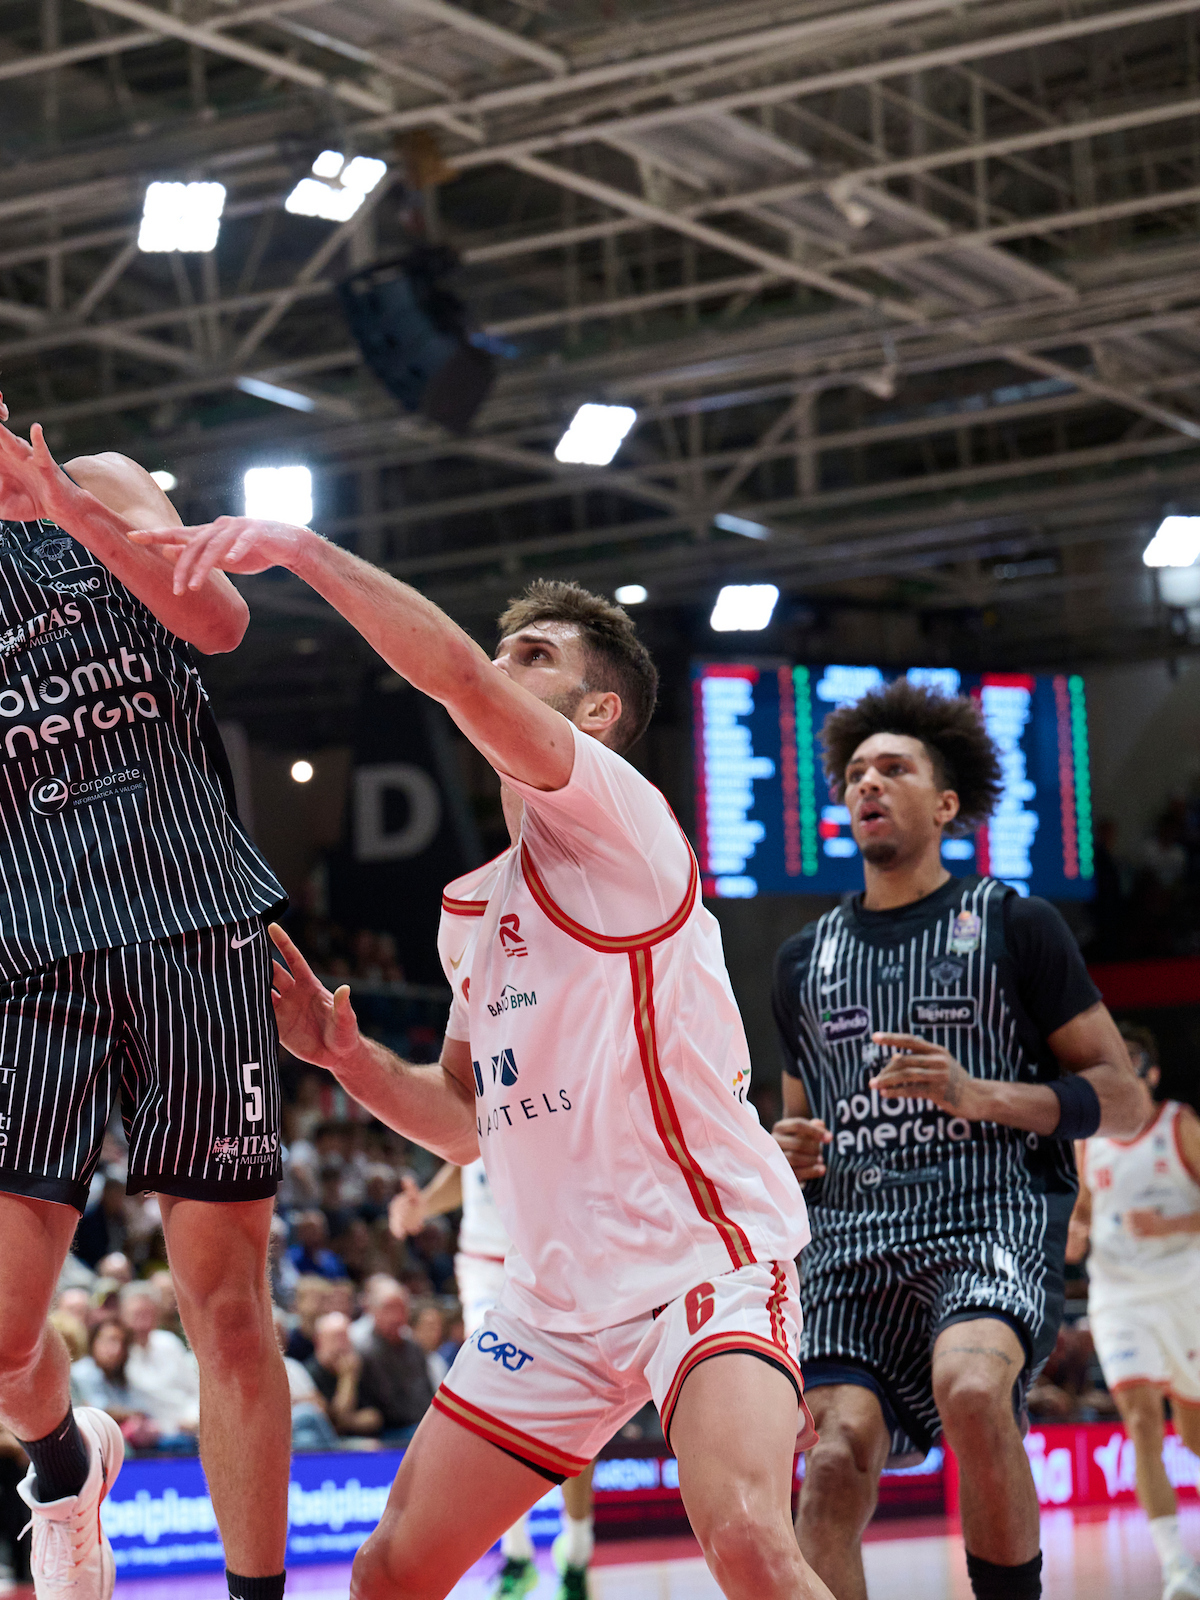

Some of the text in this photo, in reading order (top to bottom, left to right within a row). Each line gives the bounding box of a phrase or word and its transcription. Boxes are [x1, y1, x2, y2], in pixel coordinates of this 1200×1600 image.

[26, 601, 82, 638] ITAS
[29, 628, 72, 649] MUTUA
[69, 768, 141, 796] Corporate
[353, 763, 444, 862] D
[510, 990, 537, 1009] BPM
[242, 1062, 263, 1122] 5
[241, 1132, 277, 1156] ITAS
[685, 1281, 716, 1336] 6
